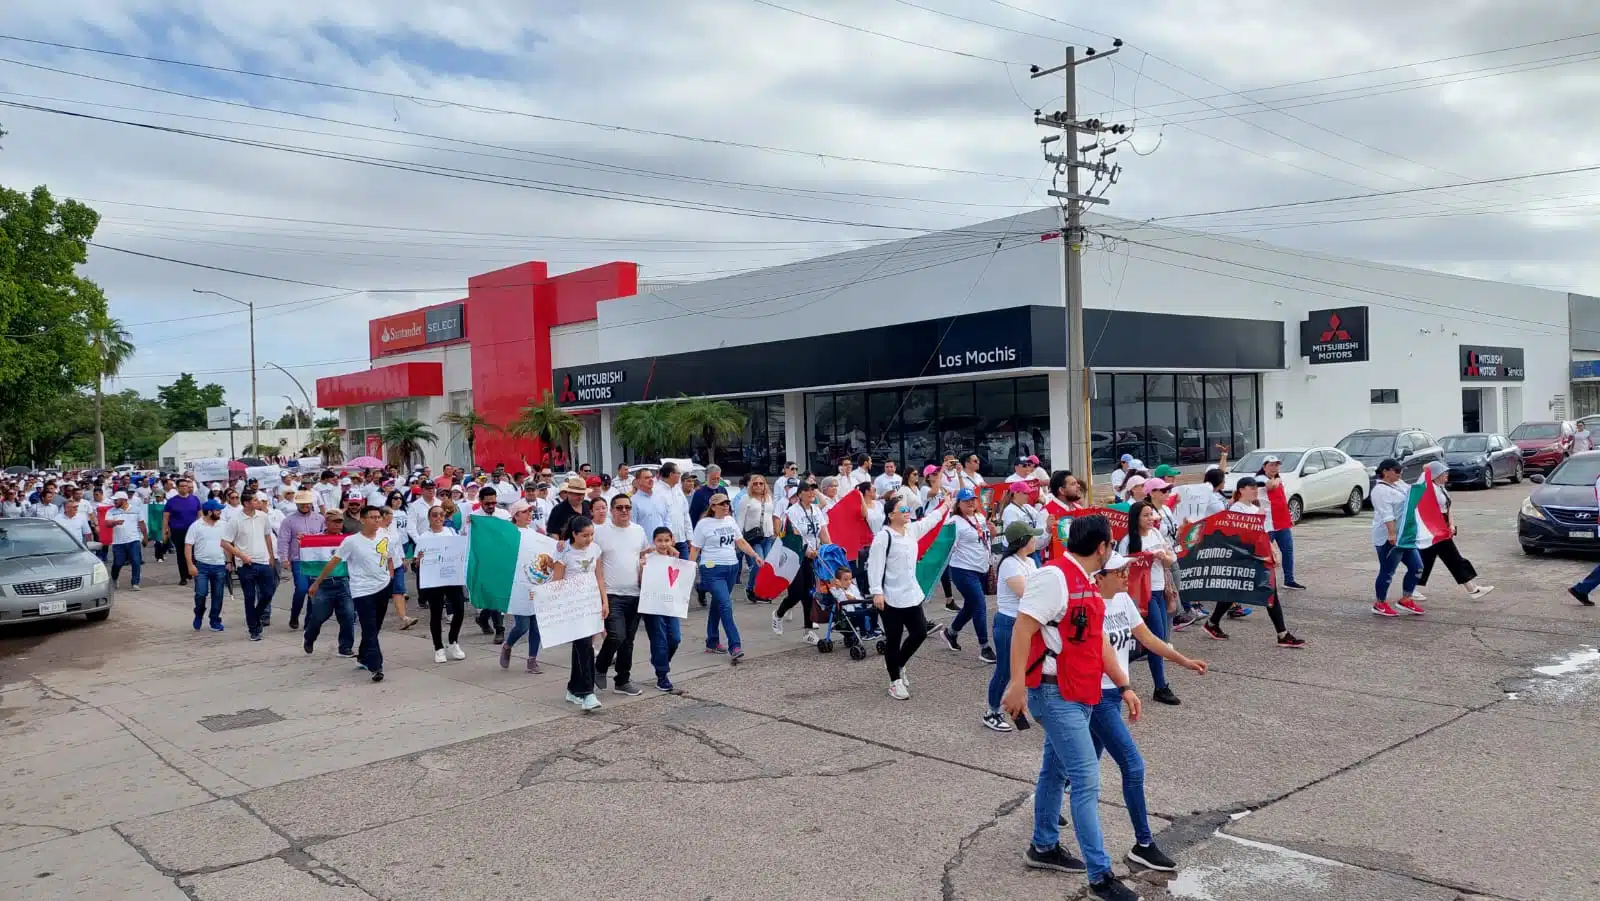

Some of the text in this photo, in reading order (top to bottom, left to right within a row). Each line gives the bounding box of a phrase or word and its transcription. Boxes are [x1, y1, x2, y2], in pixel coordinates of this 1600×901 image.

[391, 319, 457, 340] Santander SELECT
[1312, 342, 1359, 352] MITSUBISHI
[939, 346, 1016, 368] Los Mochis
[1318, 351, 1353, 360] MOTORS
[1478, 354, 1503, 365] MITSUBISHI
[1479, 366, 1497, 376] MOTORS
[577, 371, 623, 386] MITSUBISHI
[578, 387, 612, 401] MOTORS
[1196, 547, 1234, 560] PEDIMOS
[1203, 565, 1210, 576] A
[1210, 565, 1257, 579] NUESTROS
[1205, 578, 1255, 591] LABORALES
